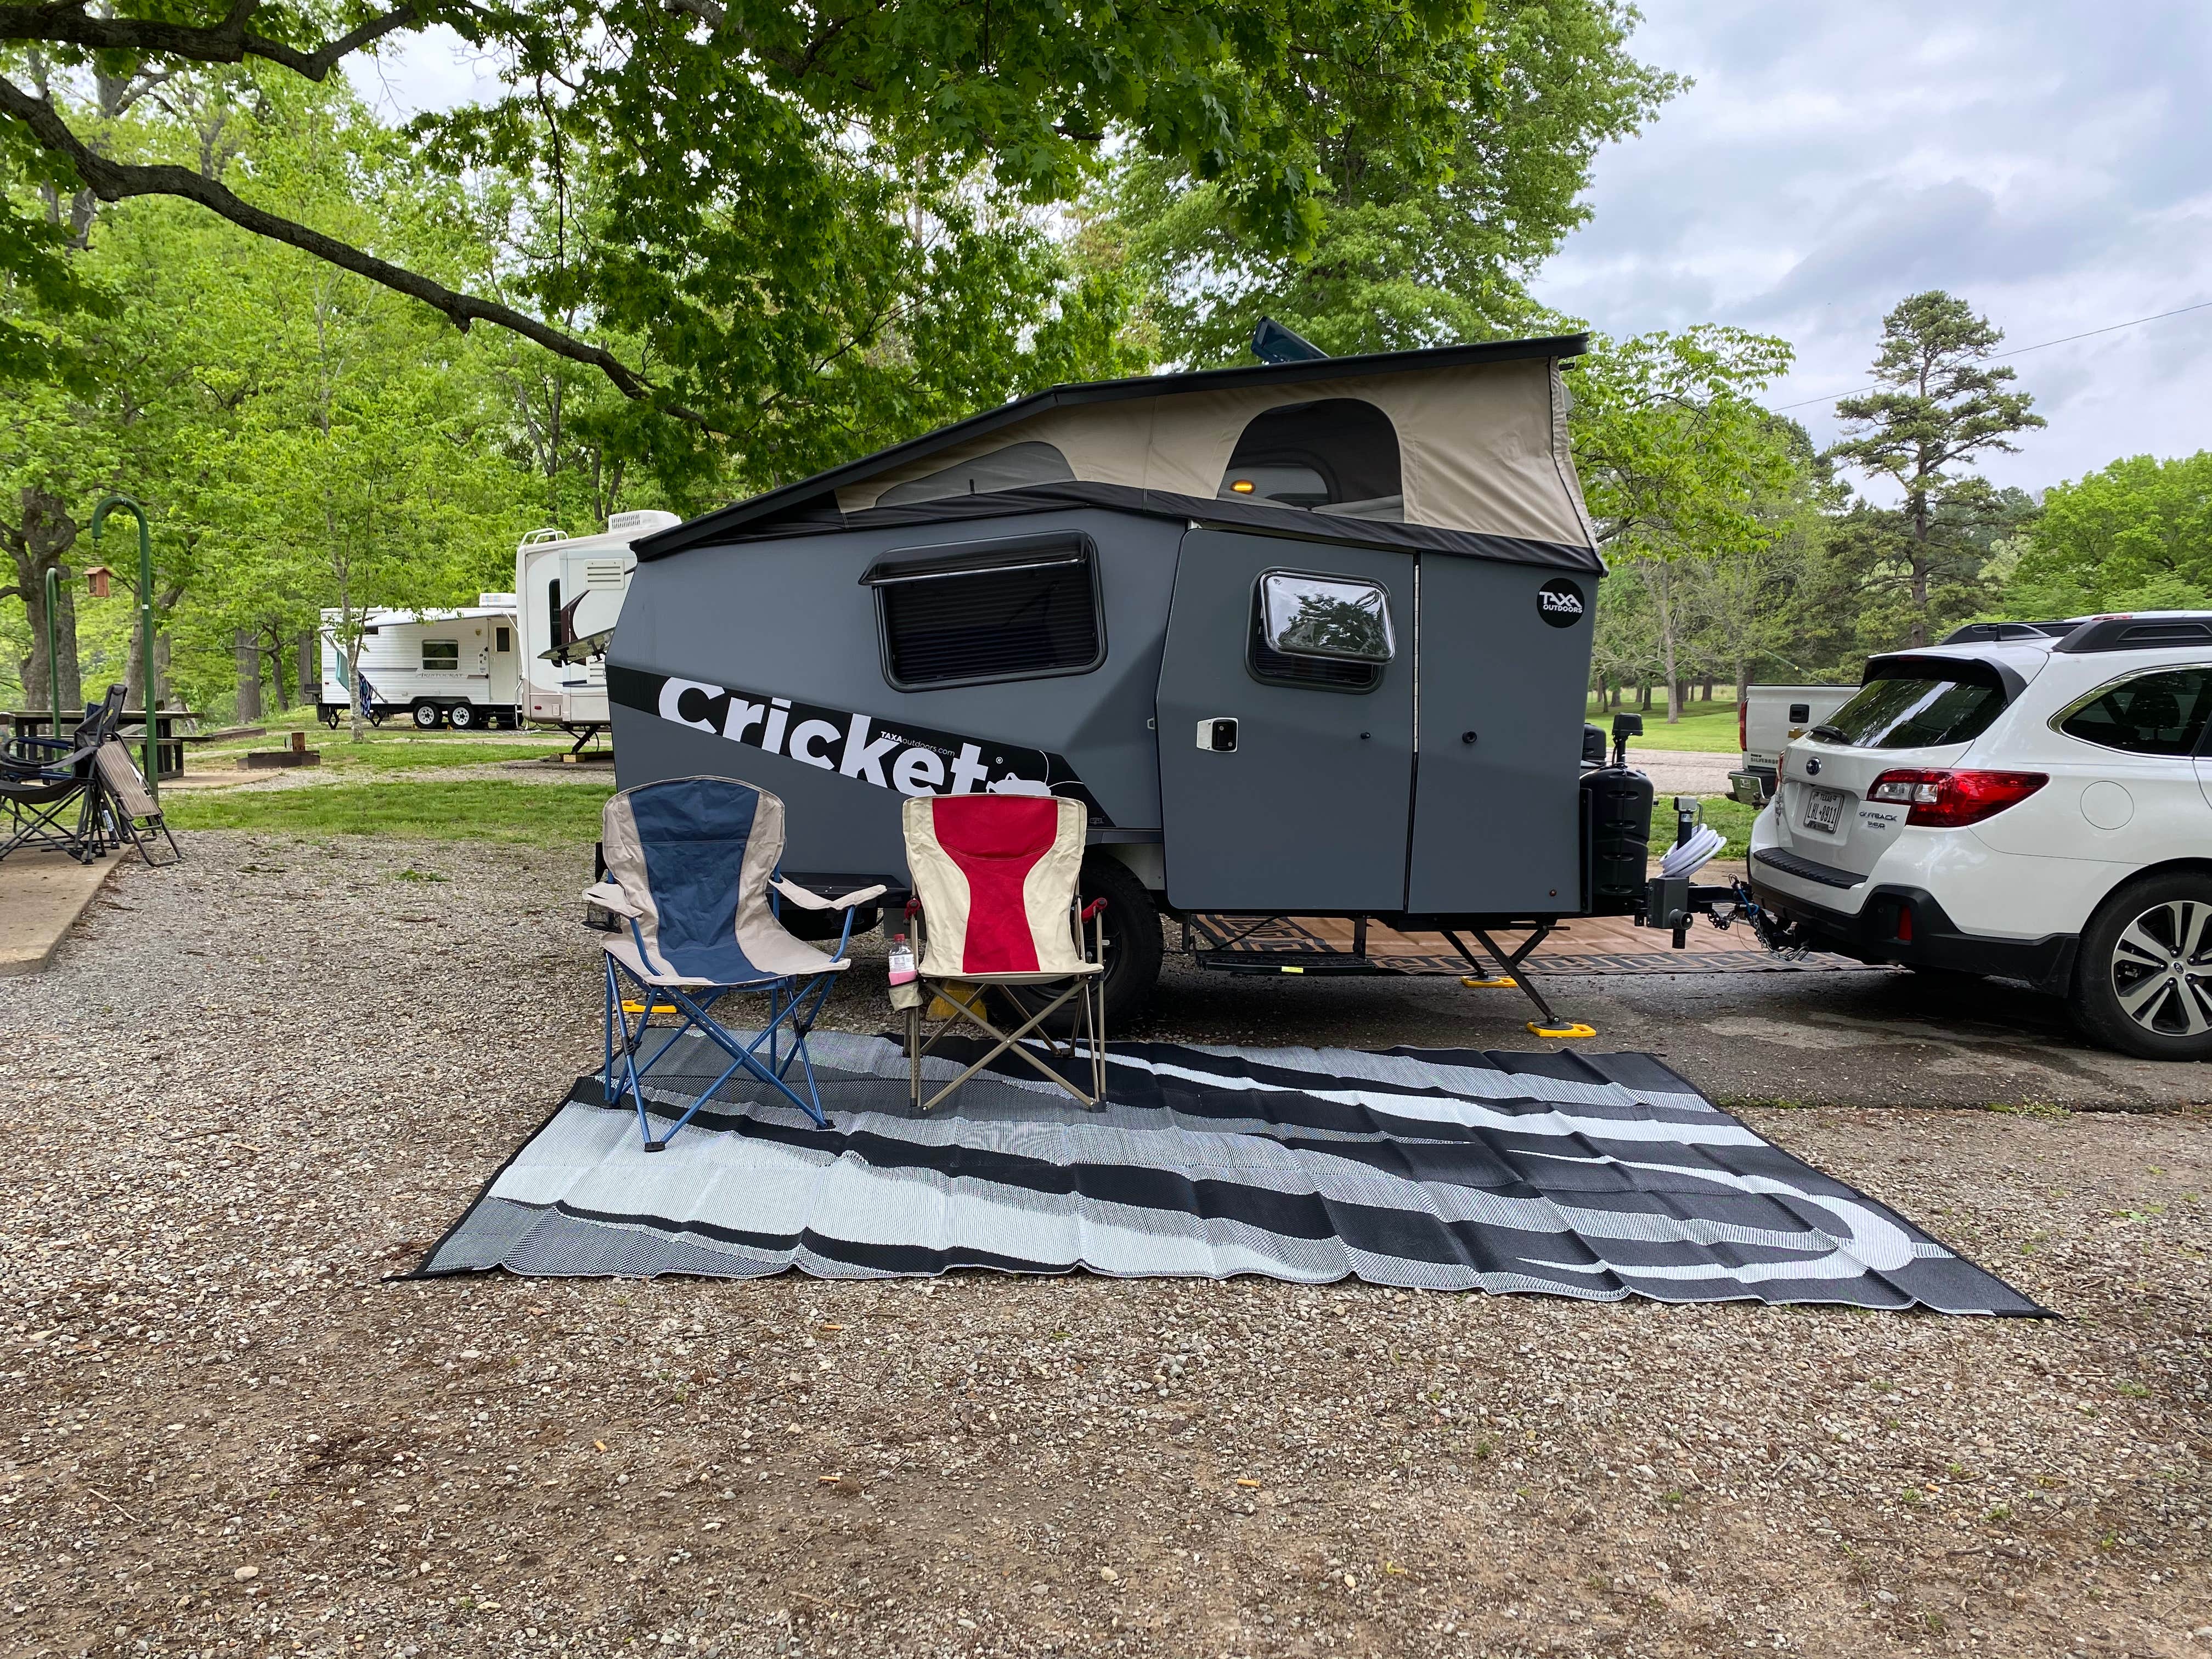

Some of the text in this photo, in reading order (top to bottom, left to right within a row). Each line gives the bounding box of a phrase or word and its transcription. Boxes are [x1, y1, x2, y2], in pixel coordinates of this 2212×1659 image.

[1539, 591, 1583, 608] TAXA
[1543, 604, 1583, 613] OUTDOORS
[659, 676, 988, 797] Cricket
[881, 731, 956, 757] TAXAoutdoors.com
